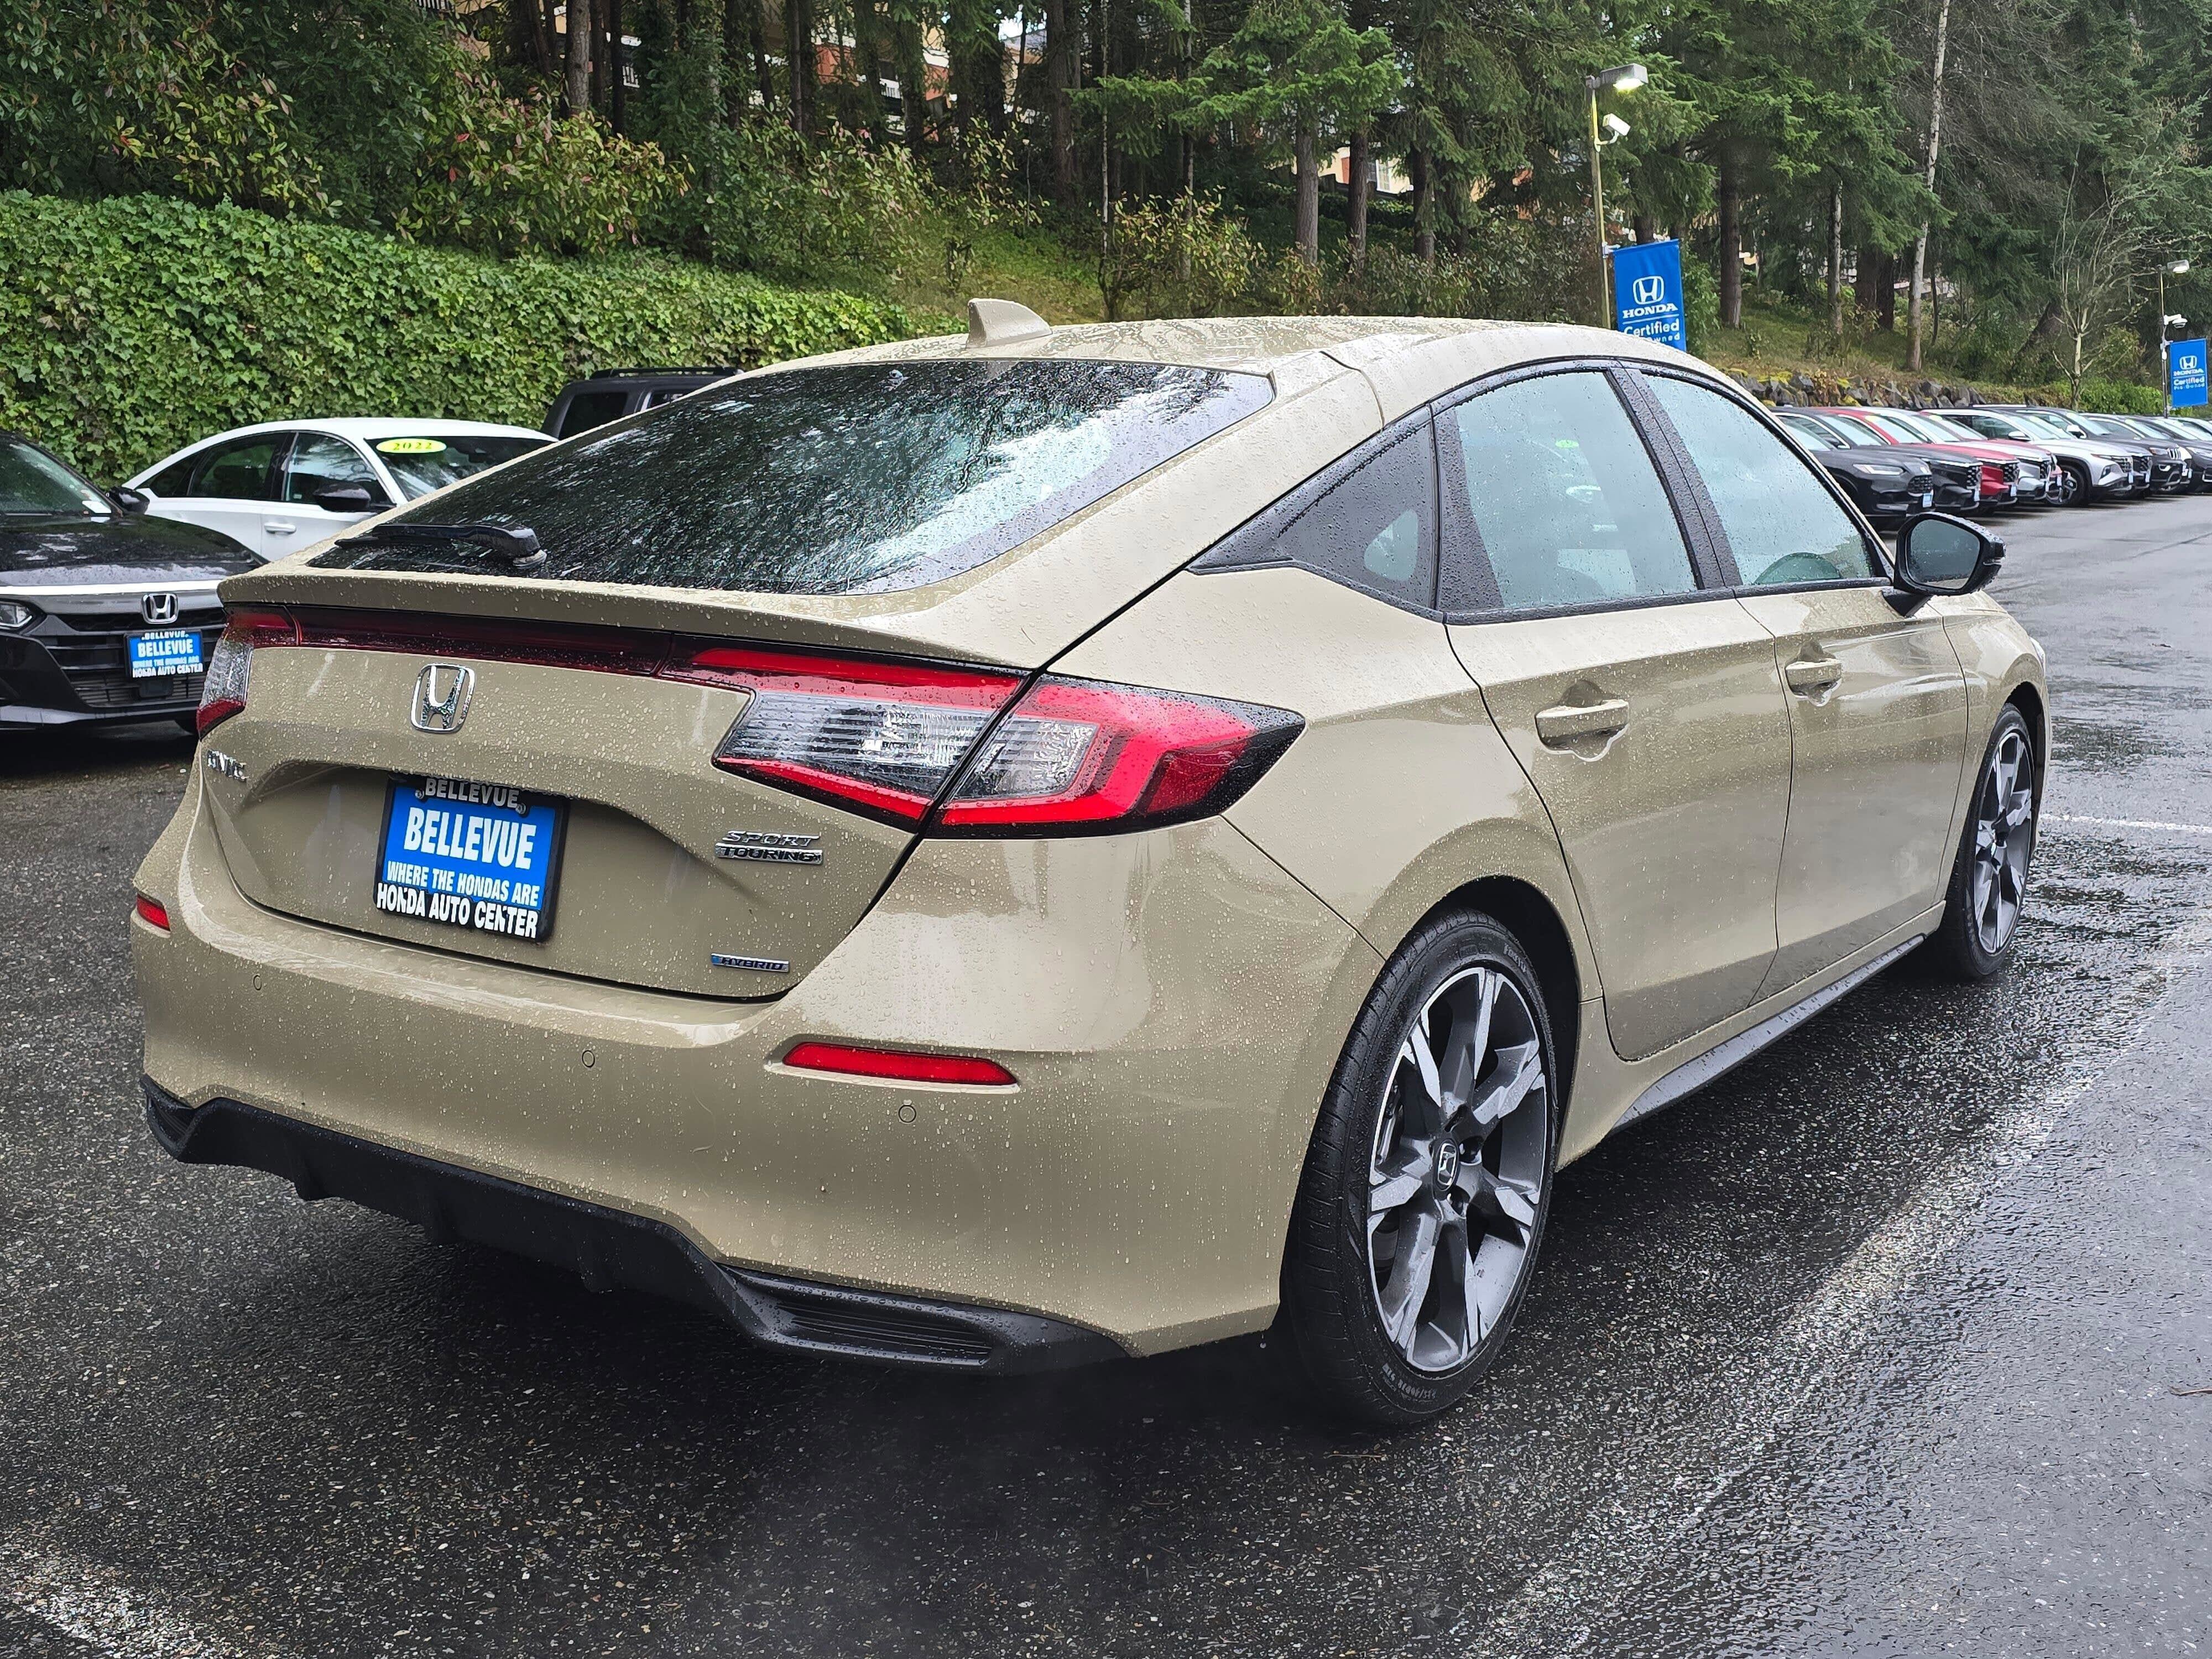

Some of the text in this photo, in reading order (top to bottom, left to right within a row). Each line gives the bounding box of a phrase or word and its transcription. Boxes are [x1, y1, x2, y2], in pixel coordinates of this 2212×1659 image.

[1623, 303, 1678, 319] HONDA
[1624, 318, 1679, 336] Certified
[2174, 376, 2205, 385] Certified
[393, 442, 432, 451] 2022
[144, 630, 186, 640] BELLEVUE
[138, 639, 193, 658] BELLEVUE
[158, 665, 176, 676] AUTO
[425, 778, 520, 808] BELLEVUE
[404, 807, 536, 869] BELLEVUE
[722, 830, 820, 847] SPORT
[718, 845, 816, 863] TOURING
[387, 860, 540, 907] WHERE THE HONDAS ARE
[377, 883, 539, 939] HONDA AUTO CENTER
[721, 956, 784, 971] HYBRID
